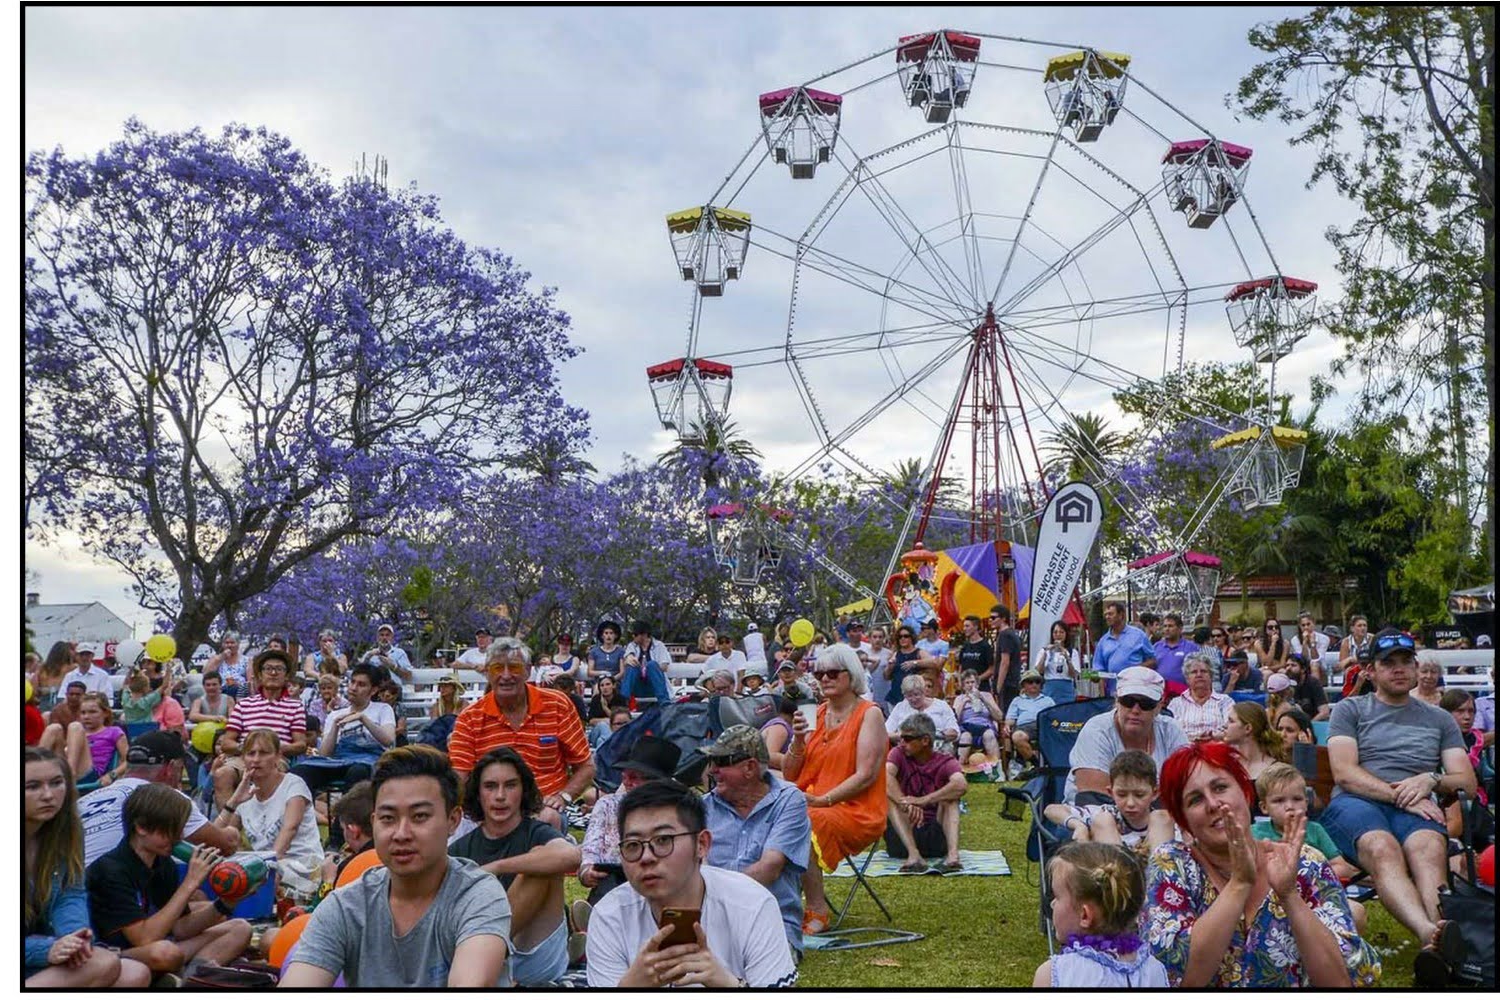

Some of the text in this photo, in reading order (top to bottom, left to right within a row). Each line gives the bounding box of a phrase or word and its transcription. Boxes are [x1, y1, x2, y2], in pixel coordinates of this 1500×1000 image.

[1034, 542, 1064, 606] NEWCASTLE
[1041, 547, 1071, 612] PERMANENT
[1050, 594, 1064, 616] Here
[1058, 582, 1069, 596] for
